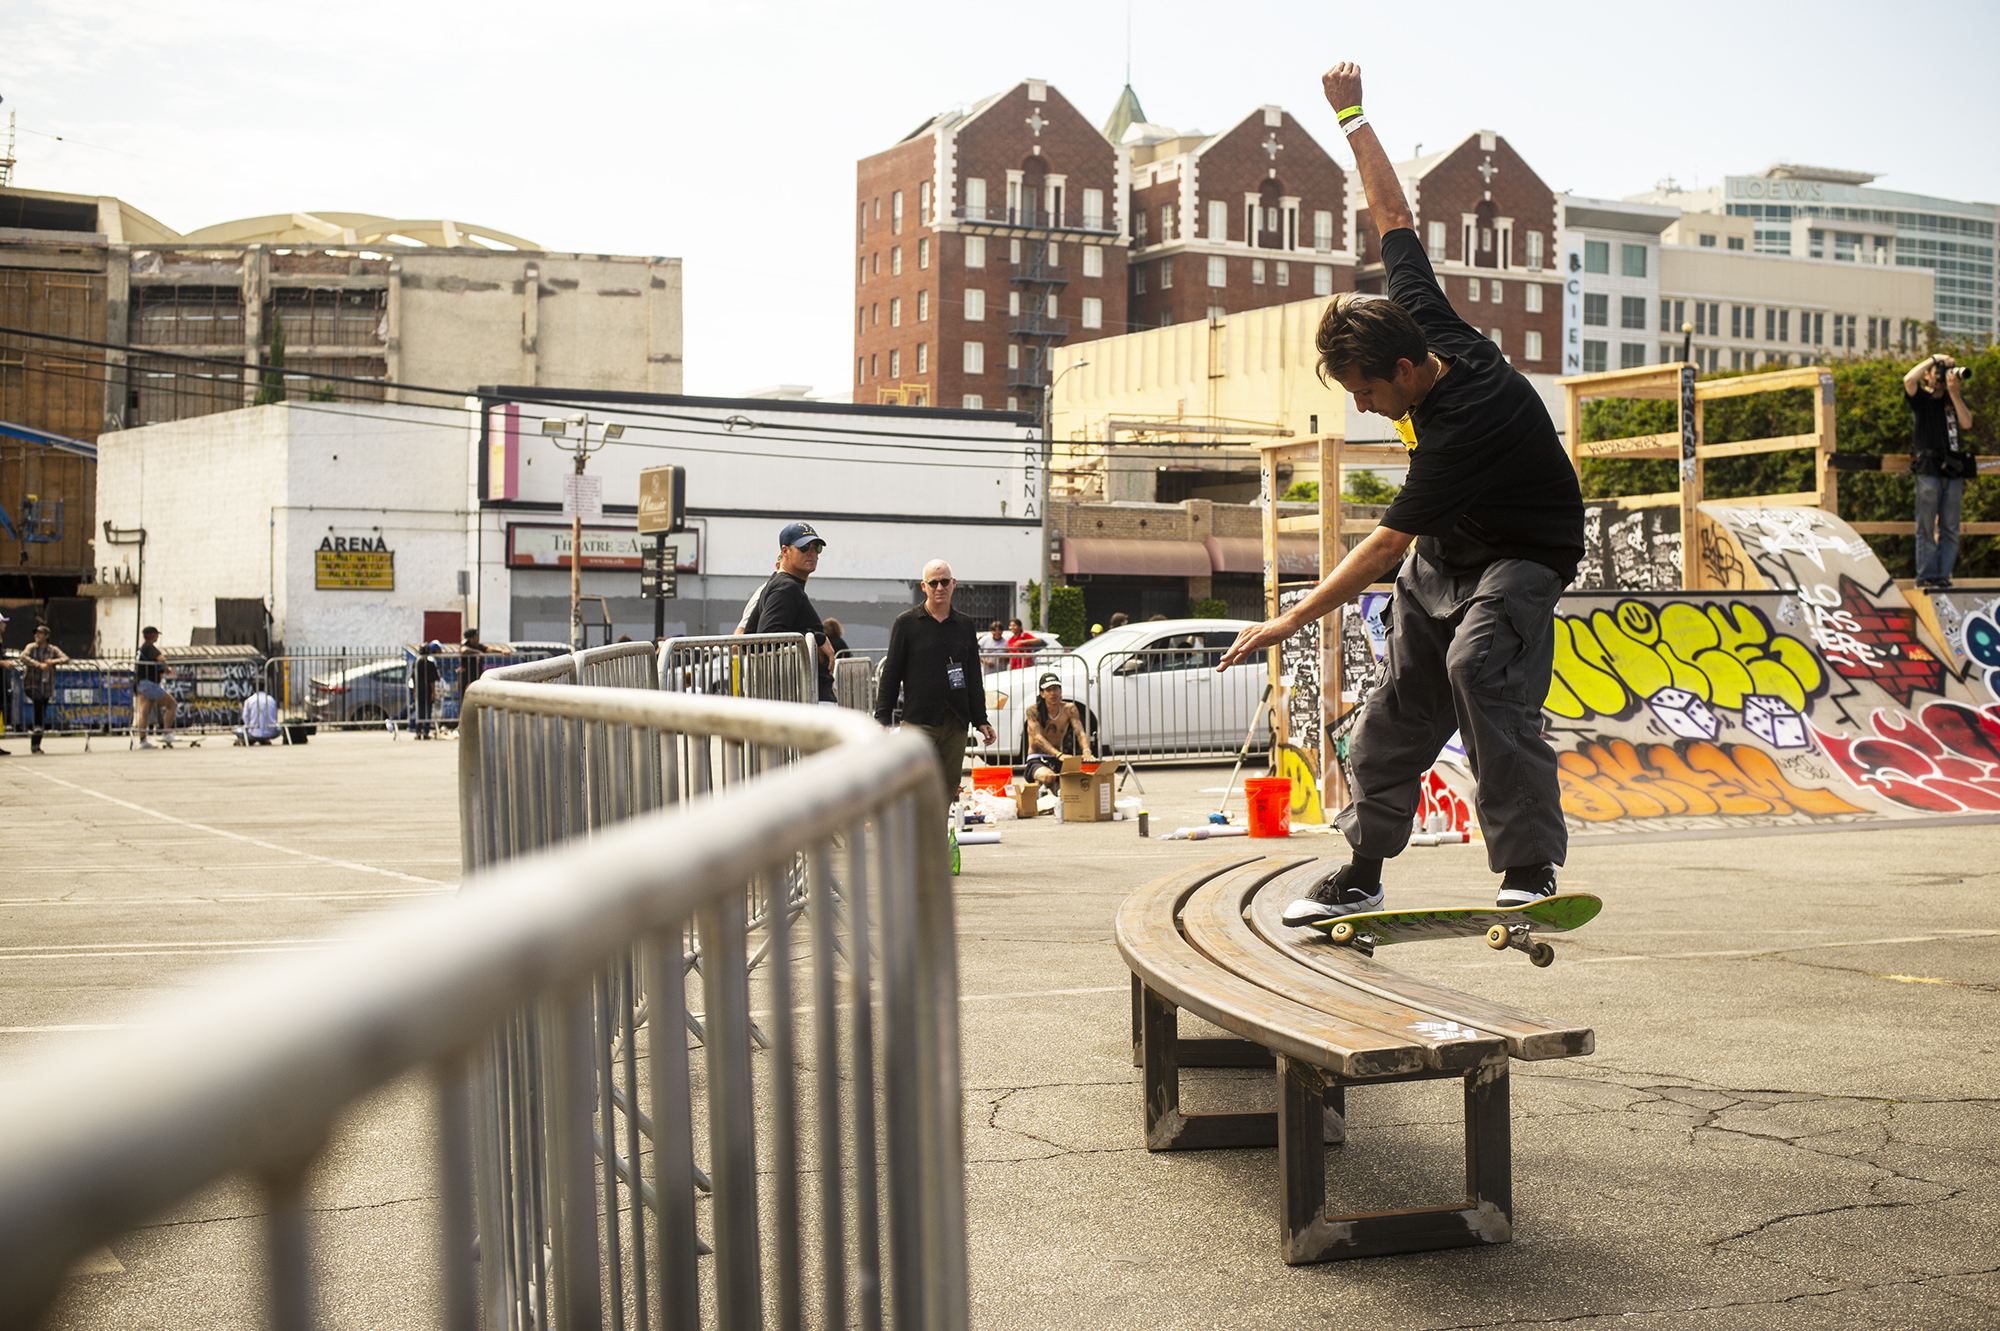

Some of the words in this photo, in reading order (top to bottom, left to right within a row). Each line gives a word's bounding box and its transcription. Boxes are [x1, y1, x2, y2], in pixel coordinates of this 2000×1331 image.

[1732, 180, 1824, 200] LOEWS
[1024, 429, 1036, 517] ARENA
[1323, 504, 1334, 546] WAS
[320, 537, 387, 551] ARENA
[551, 534, 613, 553] THATRE
[1323, 551, 1333, 577] HE
